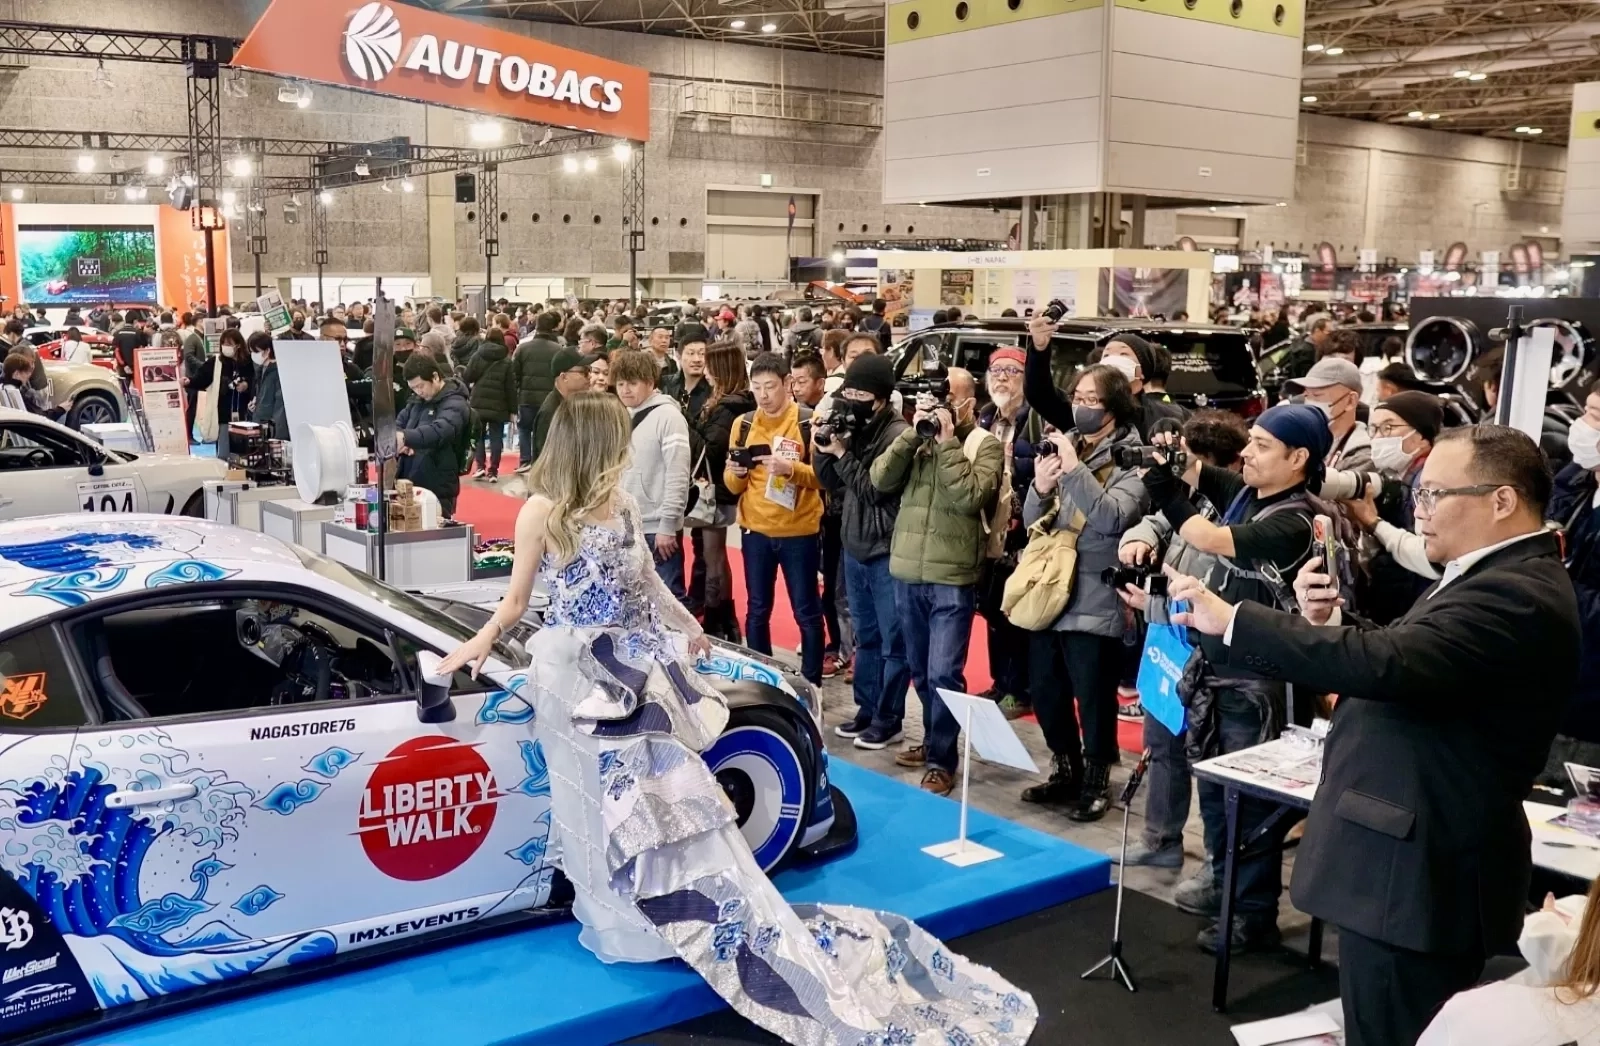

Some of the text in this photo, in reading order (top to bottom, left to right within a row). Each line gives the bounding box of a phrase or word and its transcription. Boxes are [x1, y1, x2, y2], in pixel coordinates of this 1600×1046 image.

[405, 34, 623, 113] AUTOBACS
[985, 256, 1007, 264] NAPAC
[250, 718, 356, 741] NAGASTORE76
[361, 770, 497, 819] LIBERTY
[349, 906, 480, 944] IMX.EVENTS
[30, 987, 77, 1006] WORKS
